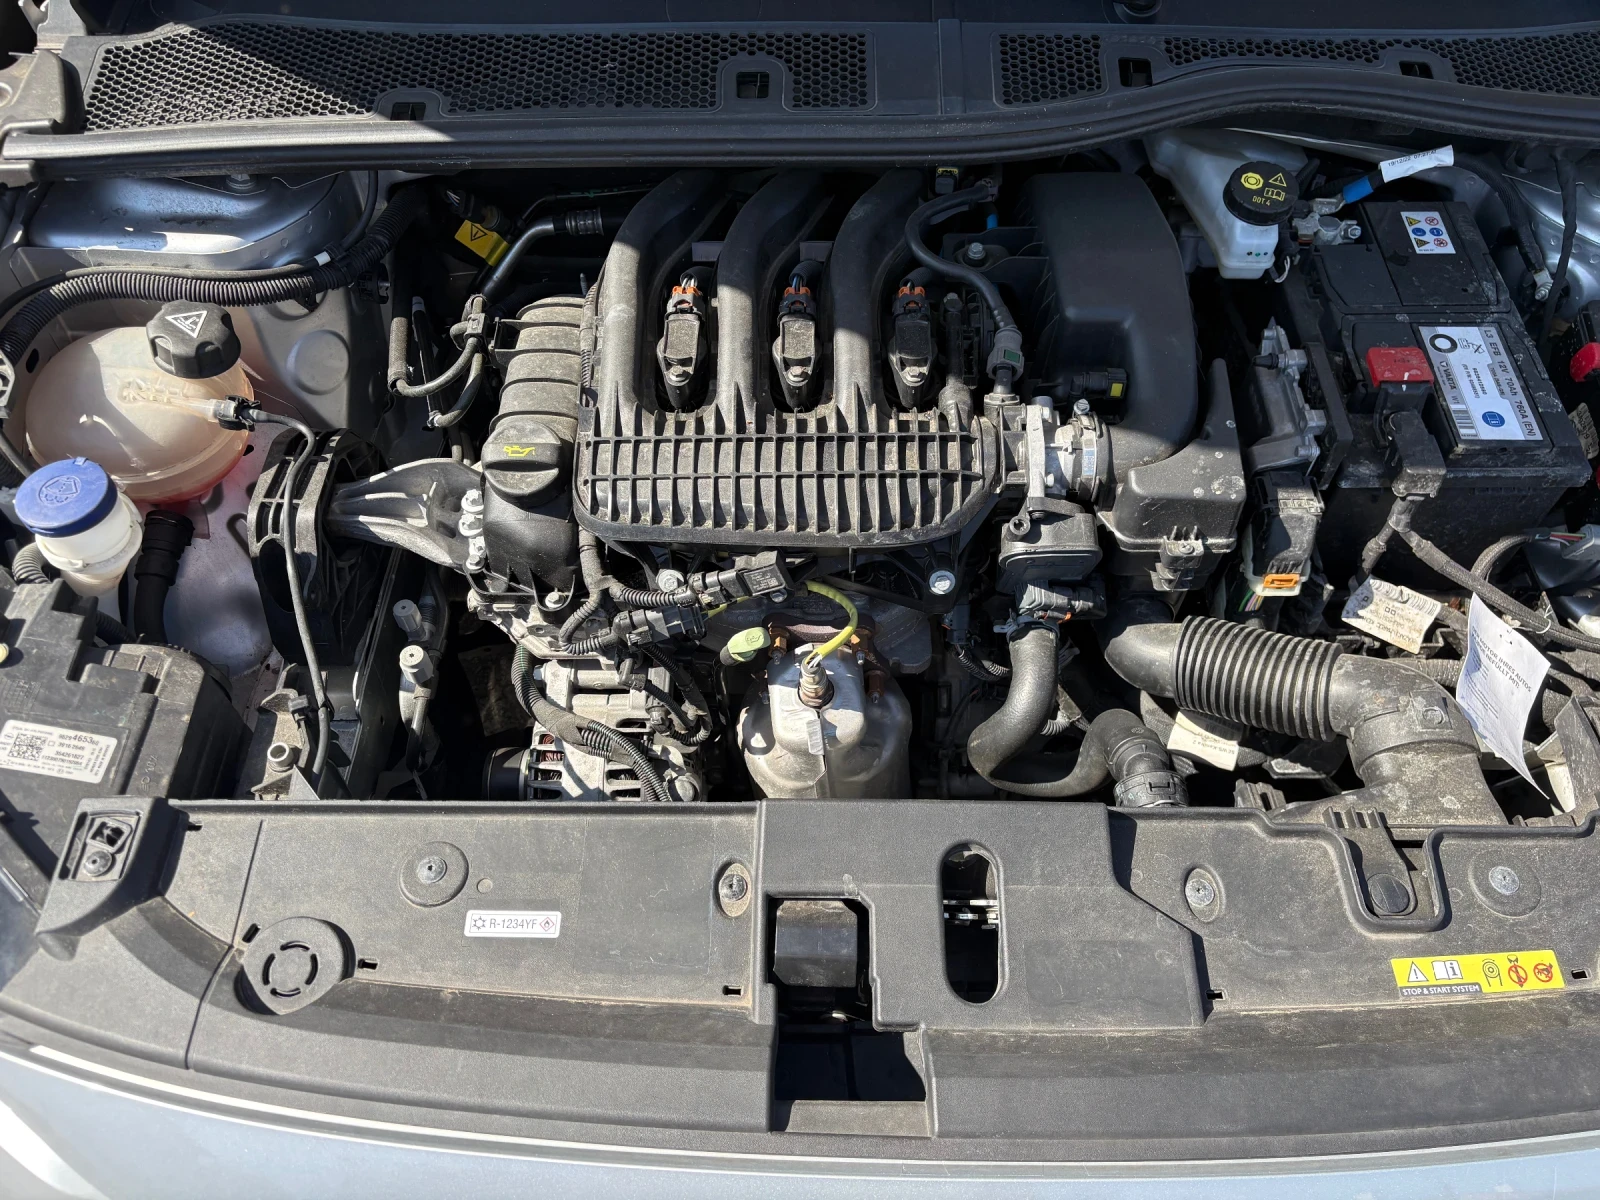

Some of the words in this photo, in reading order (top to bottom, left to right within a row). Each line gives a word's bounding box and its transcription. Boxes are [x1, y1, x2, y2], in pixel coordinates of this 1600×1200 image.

[1252, 195, 1265, 204] DOT
[1444, 365, 1457, 390] VARTA
[1484, 329, 1493, 339] L3
[1489, 342, 1501, 357] EFB
[1497, 360, 1509, 374] 12V
[1505, 378, 1518, 396] 70Ah
[1514, 400, 1528, 420] 760A
[1522, 420, 1536, 437] (EN)
[1480, 637, 1498, 659] MOTOR
[1498, 657, 1516, 675] IHRES
[1515, 673, 1532, 692] AUTOS
[489, 917, 538, 930] R-1234YF
[1402, 988, 1421, 996] STOP
[1422, 987, 1429, 995] &
[1429, 986, 1451, 994] START
[1452, 984, 1480, 993] SYSTEM
